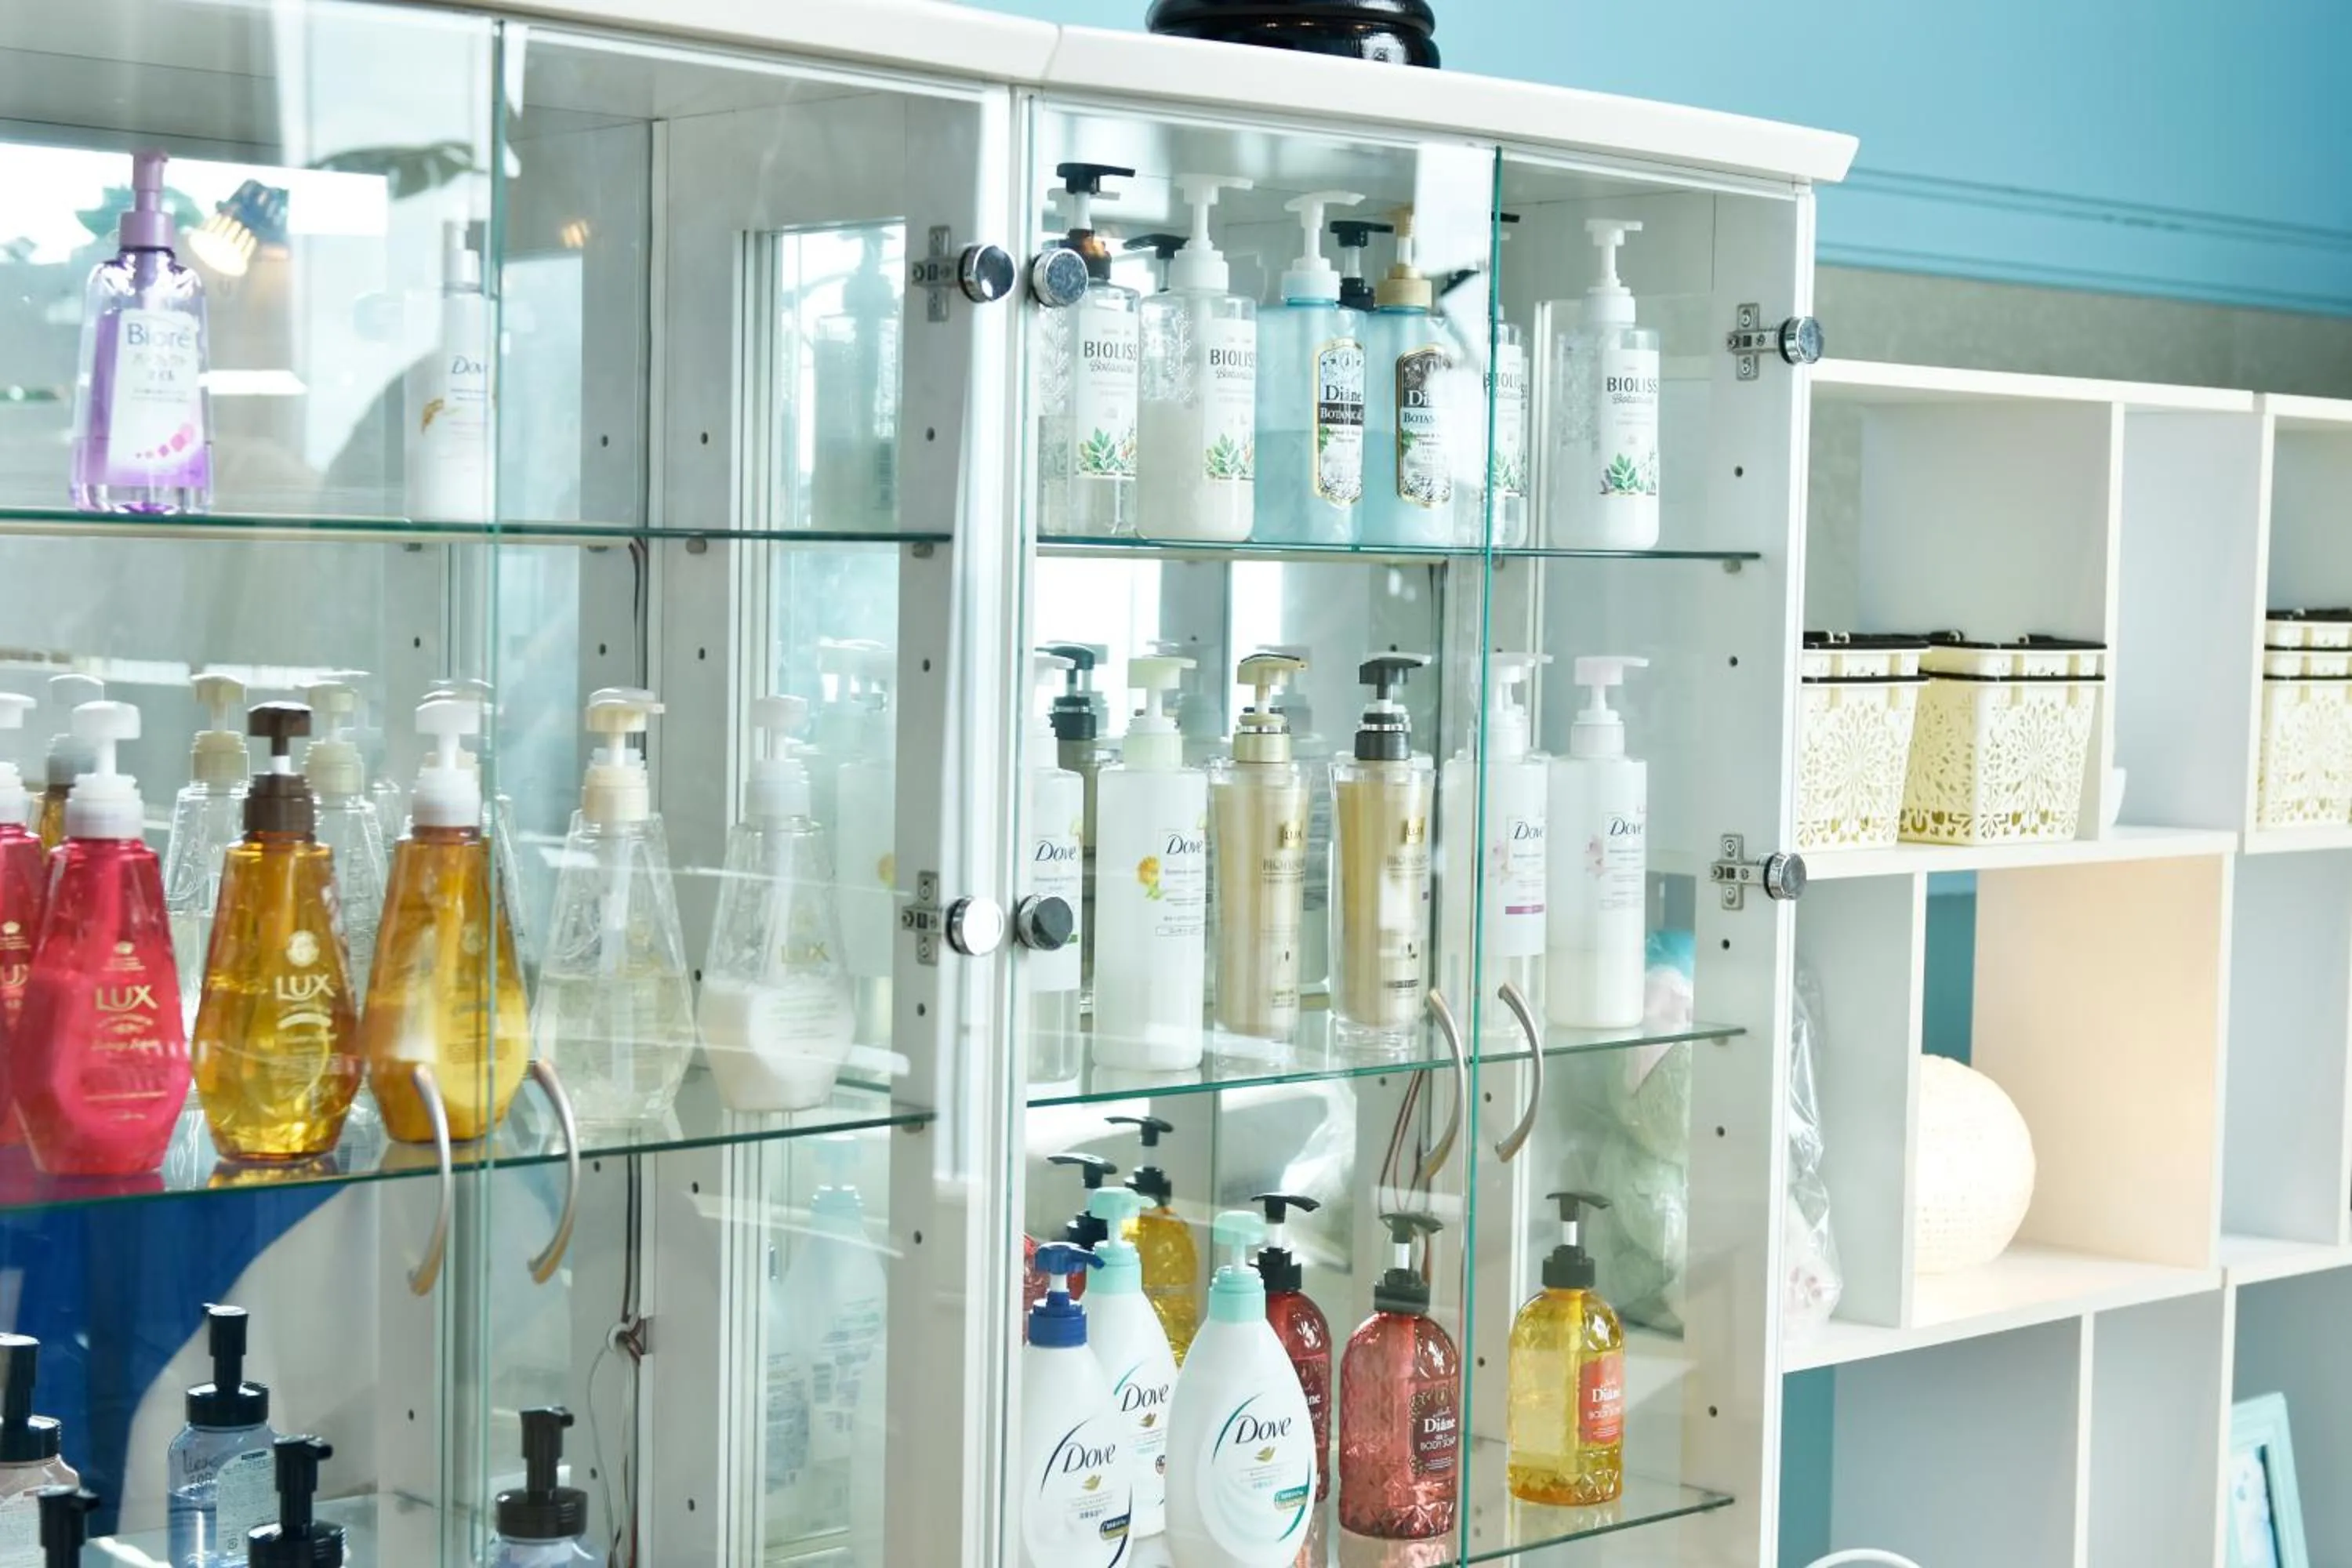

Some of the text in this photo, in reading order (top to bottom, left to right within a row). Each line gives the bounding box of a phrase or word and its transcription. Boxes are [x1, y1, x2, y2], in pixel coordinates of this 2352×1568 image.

[452, 354, 488, 375] Dov
[1209, 349, 1254, 368] BIOLIS
[1035, 840, 1076, 862] Dove
[1167, 833, 1203, 855] Dove
[96, 985, 159, 1011] LUX
[276, 974, 336, 1001] LUX
[1122, 1382, 1169, 1412] Dove
[1234, 1414, 1291, 1445] Dove
[1063, 1442, 1116, 1474] Dove
